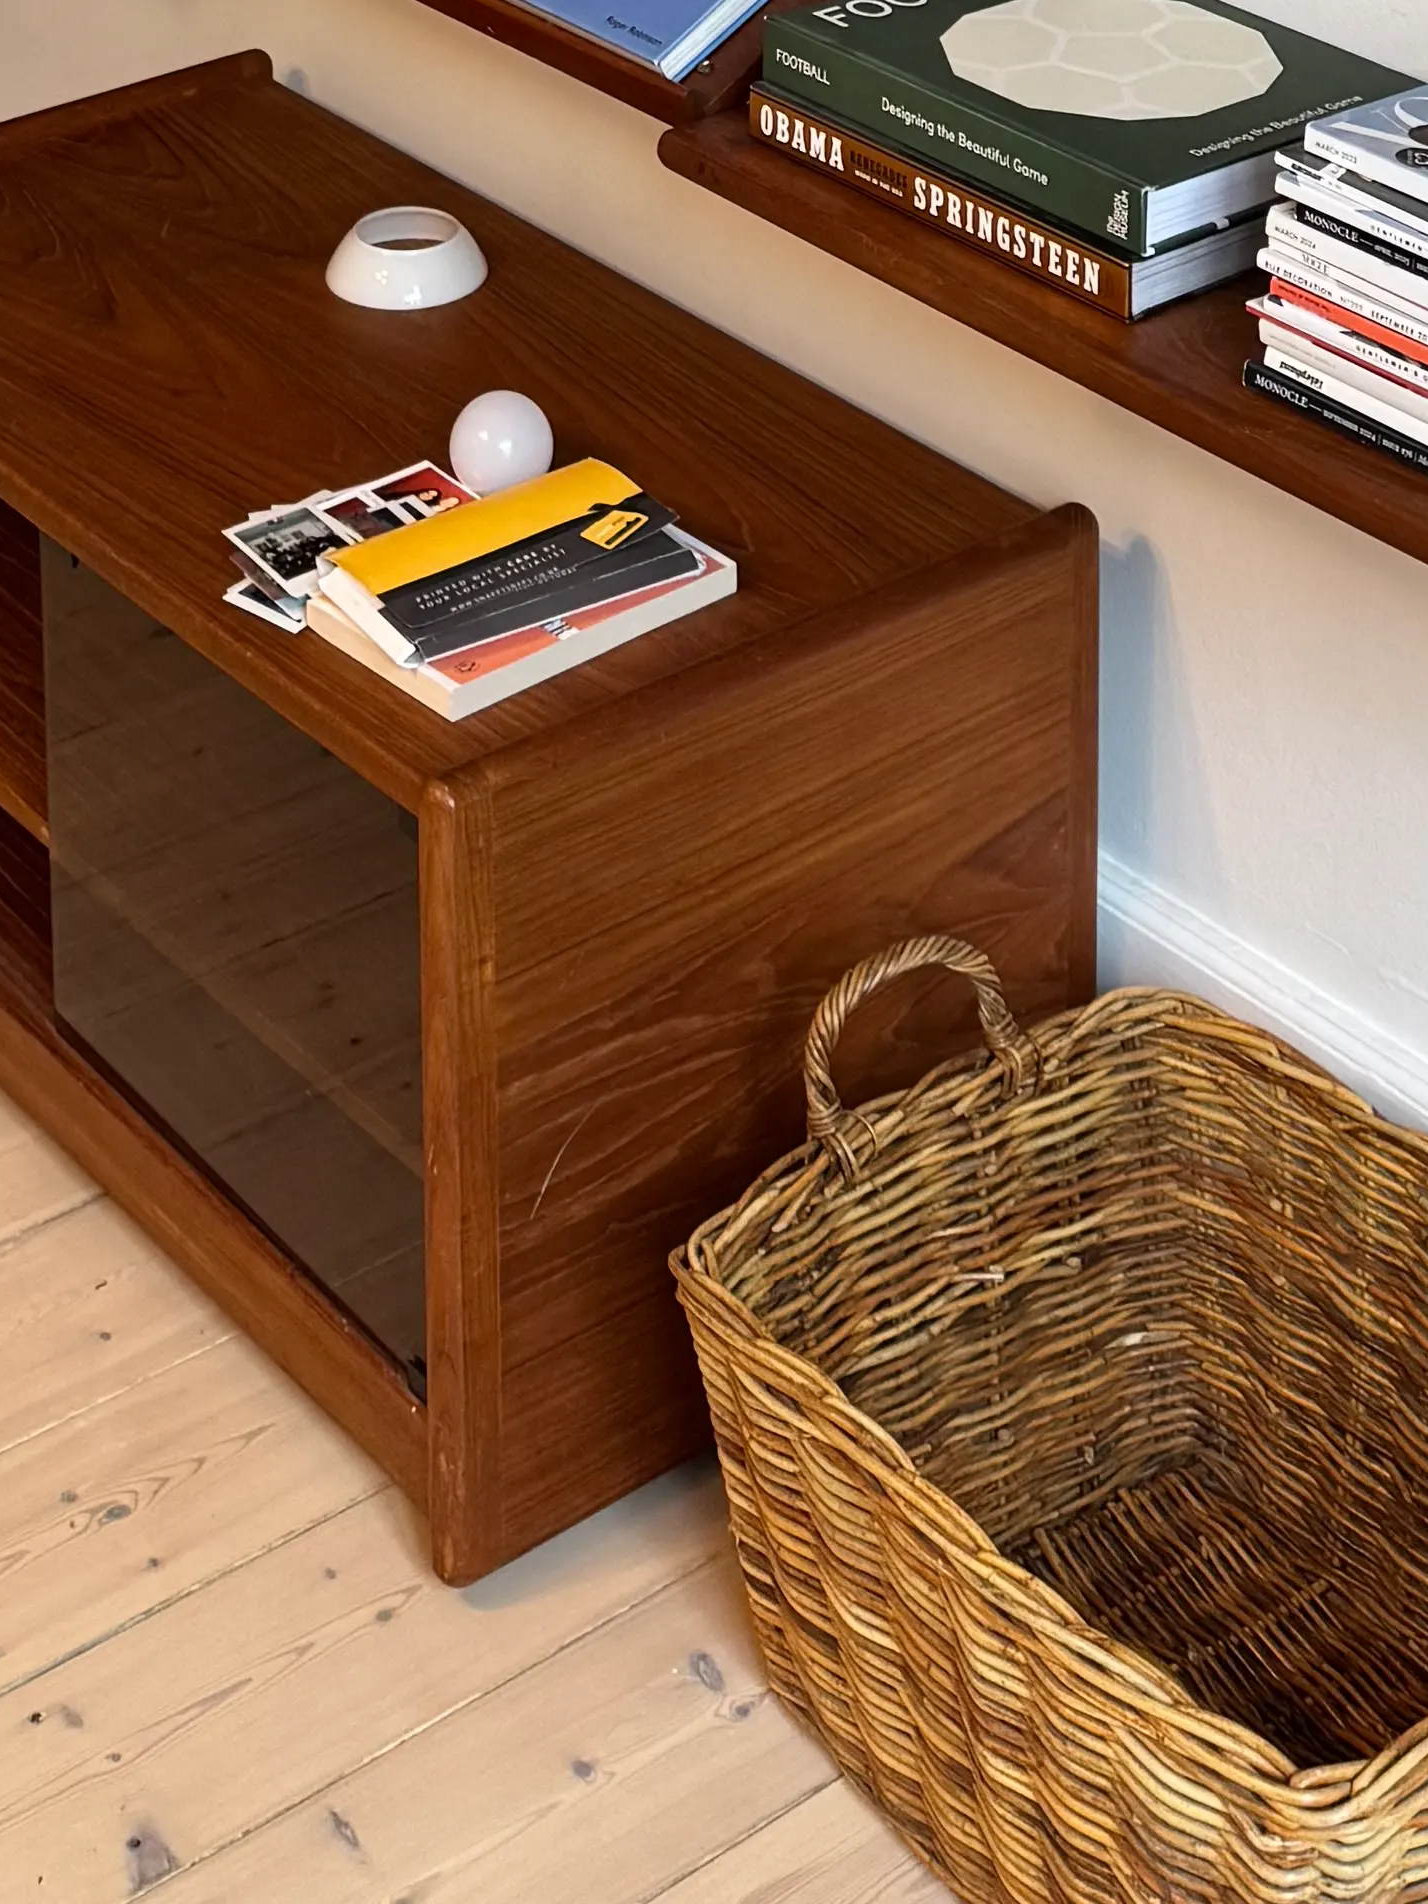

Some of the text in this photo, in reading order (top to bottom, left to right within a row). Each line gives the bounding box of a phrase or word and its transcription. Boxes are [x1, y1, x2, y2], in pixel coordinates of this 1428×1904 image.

[606, 15, 663, 47] Roger Robinson
[775, 49, 830, 86] FOOTBALL
[759, 104, 844, 172] OBAMA
[913, 176, 1100, 295] SPRINGSTEEN
[1304, 209, 1361, 244] MONOCLE
[1370, 311, 1415, 336] SEPTEMBER
[1254, 372, 1310, 409] MONOCLE
